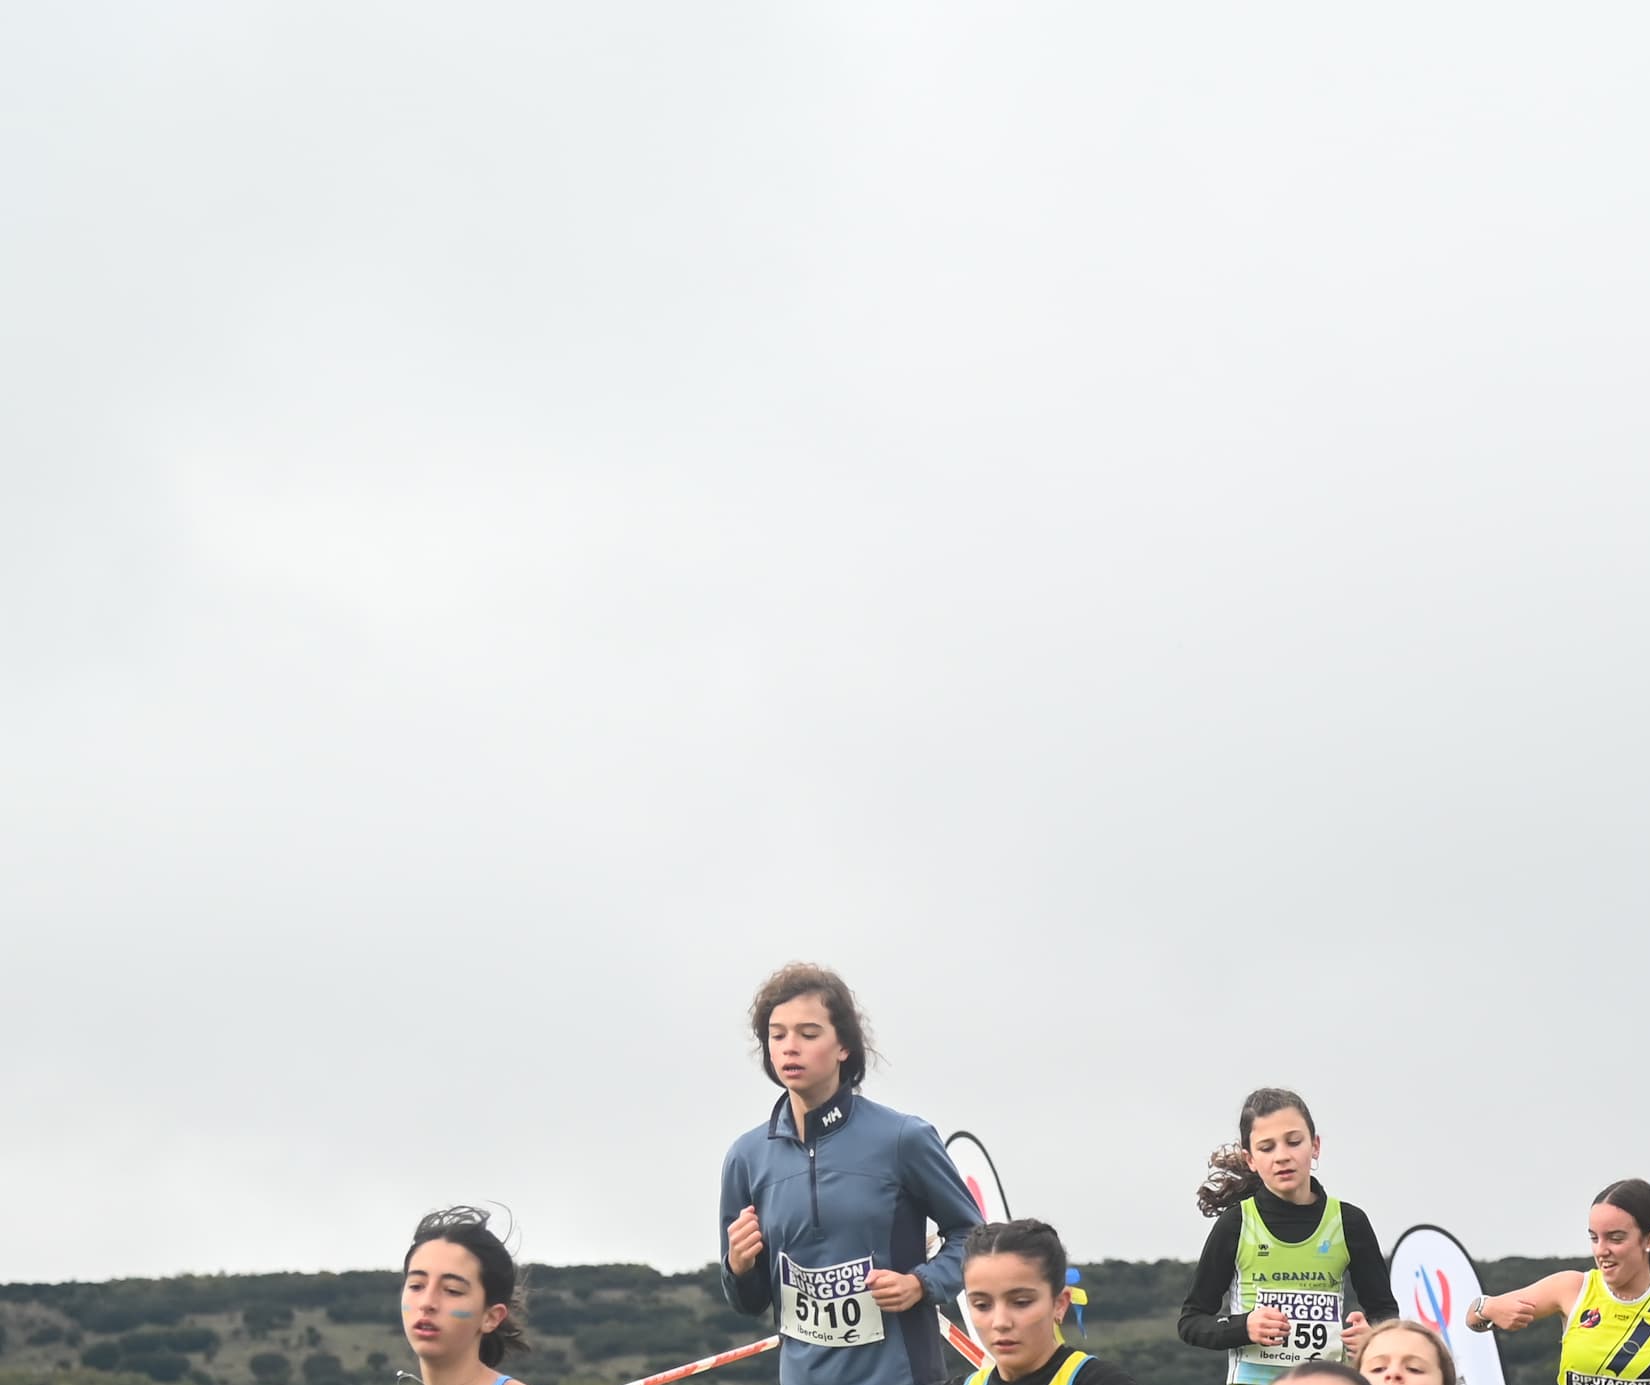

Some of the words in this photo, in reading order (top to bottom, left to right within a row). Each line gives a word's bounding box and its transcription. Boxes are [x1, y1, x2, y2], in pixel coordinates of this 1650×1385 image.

[788, 1261, 865, 1284] UTACIÓN
[1252, 1272, 1267, 1281] LA
[1272, 1271, 1325, 1281] GRANJA
[795, 1292, 861, 1329] 5110
[1256, 1303, 1334, 1320] RGOS
[1260, 1351, 1301, 1362] iberCaja
